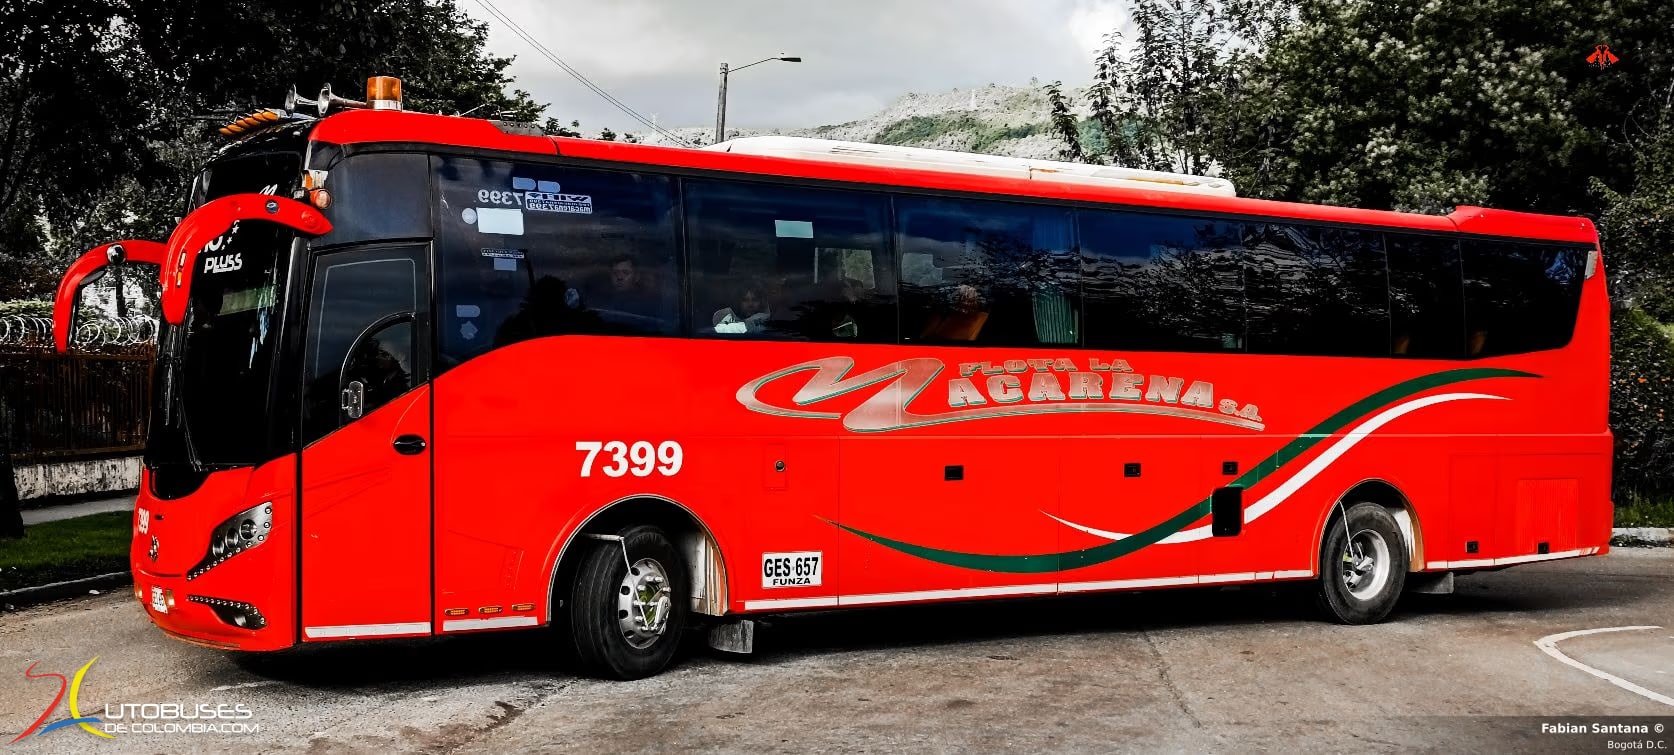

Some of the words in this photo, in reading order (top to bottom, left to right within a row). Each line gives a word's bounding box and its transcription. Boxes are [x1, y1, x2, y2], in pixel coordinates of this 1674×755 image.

[203, 252, 243, 274] PLUSS
[958, 358, 1078, 377] FLOTA
[1088, 358, 1133, 372] LA
[1217, 398, 1263, 422] S.A.
[575, 440, 684, 478] 7399
[764, 557, 791, 577] GES
[795, 556, 819, 577] 657
[772, 577, 811, 586] FUNZA
